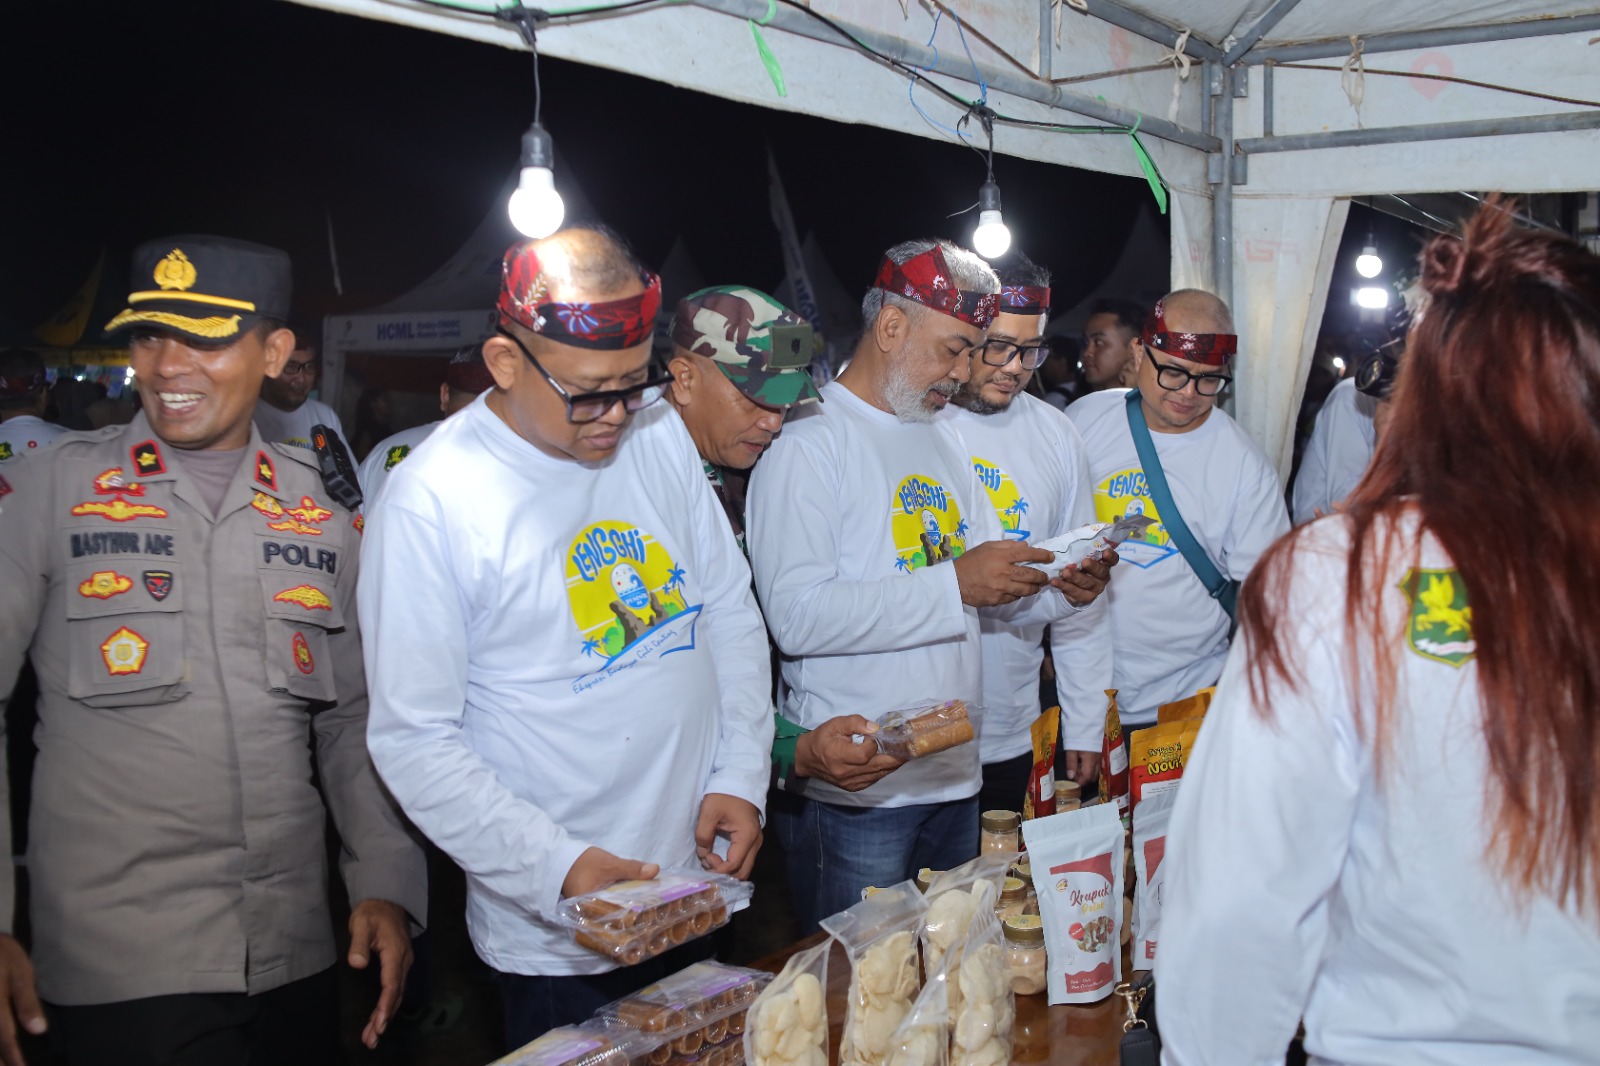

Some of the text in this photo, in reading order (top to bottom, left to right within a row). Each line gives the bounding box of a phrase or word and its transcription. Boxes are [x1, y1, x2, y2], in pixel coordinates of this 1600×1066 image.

[377, 322, 415, 341] HCML
[144, 533, 175, 556] ADE
[263, 541, 336, 574] POLRI
[1070, 881, 1109, 906] Krupuk
